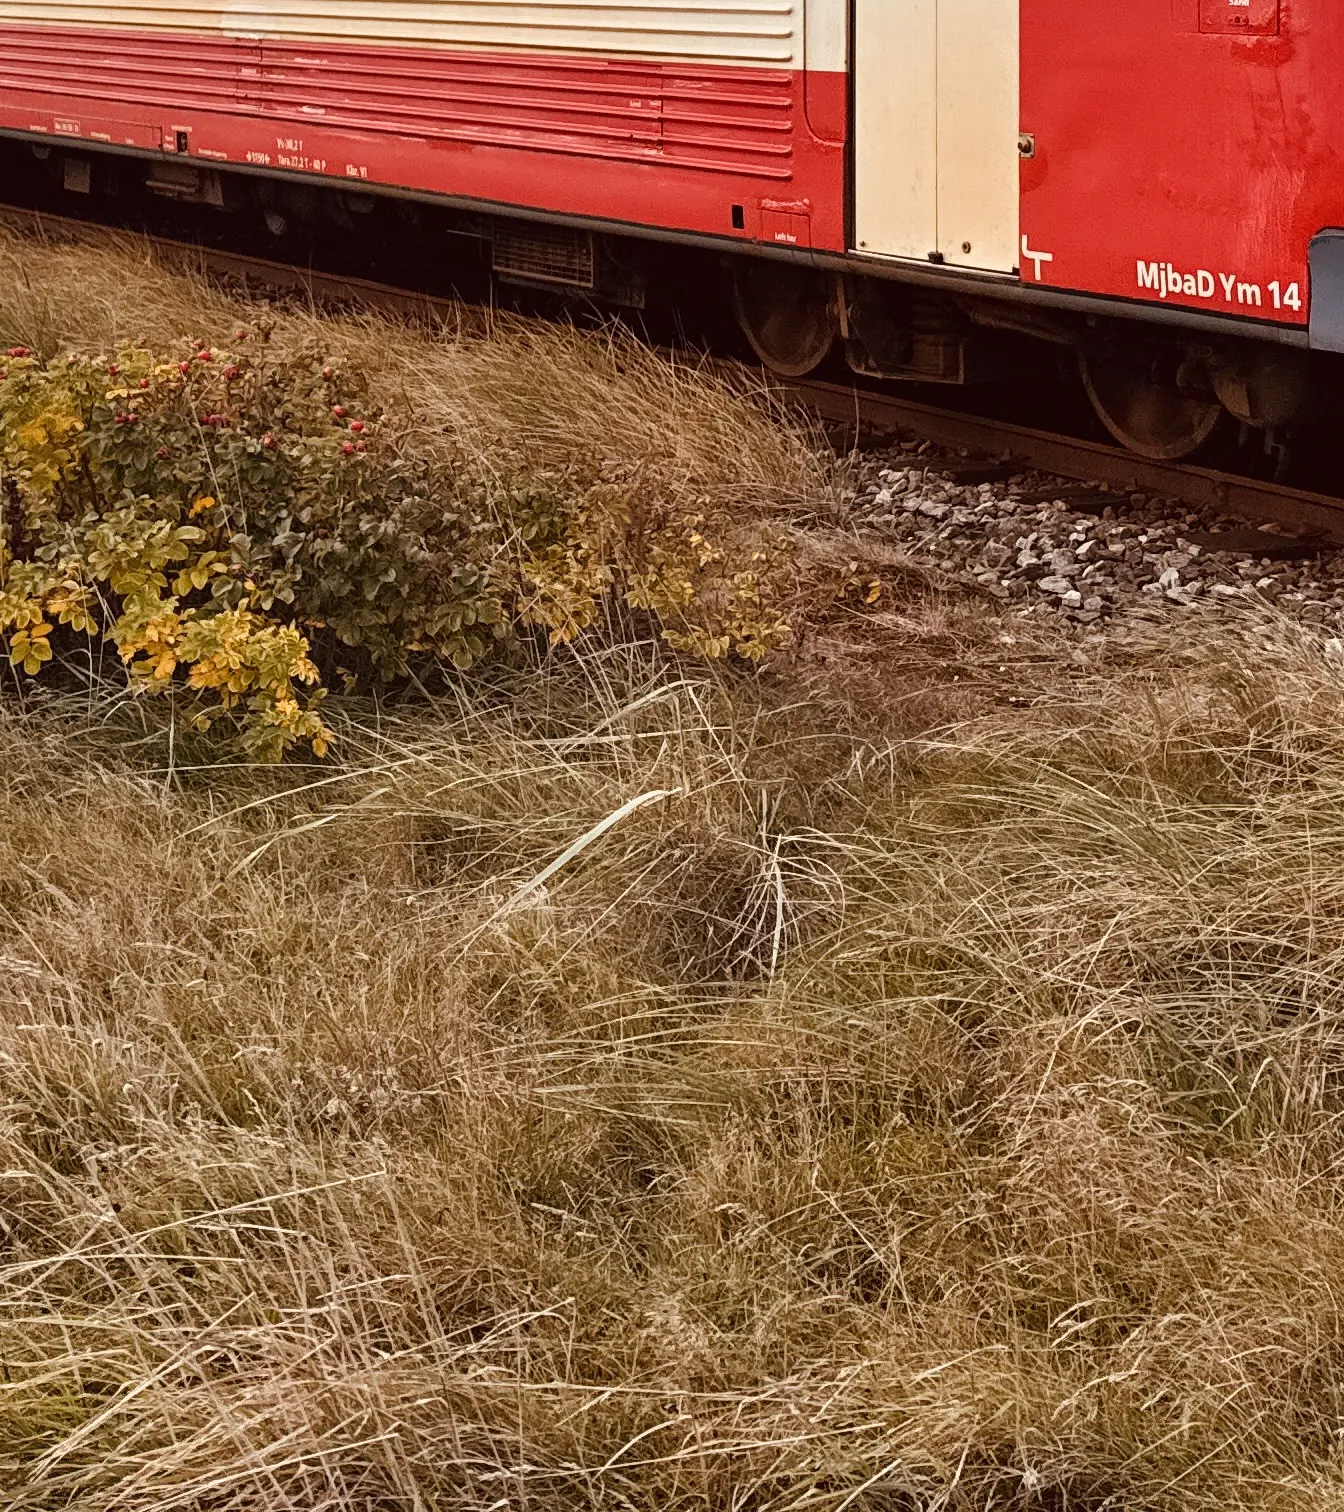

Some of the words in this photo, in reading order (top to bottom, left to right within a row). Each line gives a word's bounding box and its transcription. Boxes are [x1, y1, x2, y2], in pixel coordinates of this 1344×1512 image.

[1136, 260, 1215, 298] MjbaD
[1218, 272, 1262, 306] Ym
[1267, 280, 1302, 311] 14
